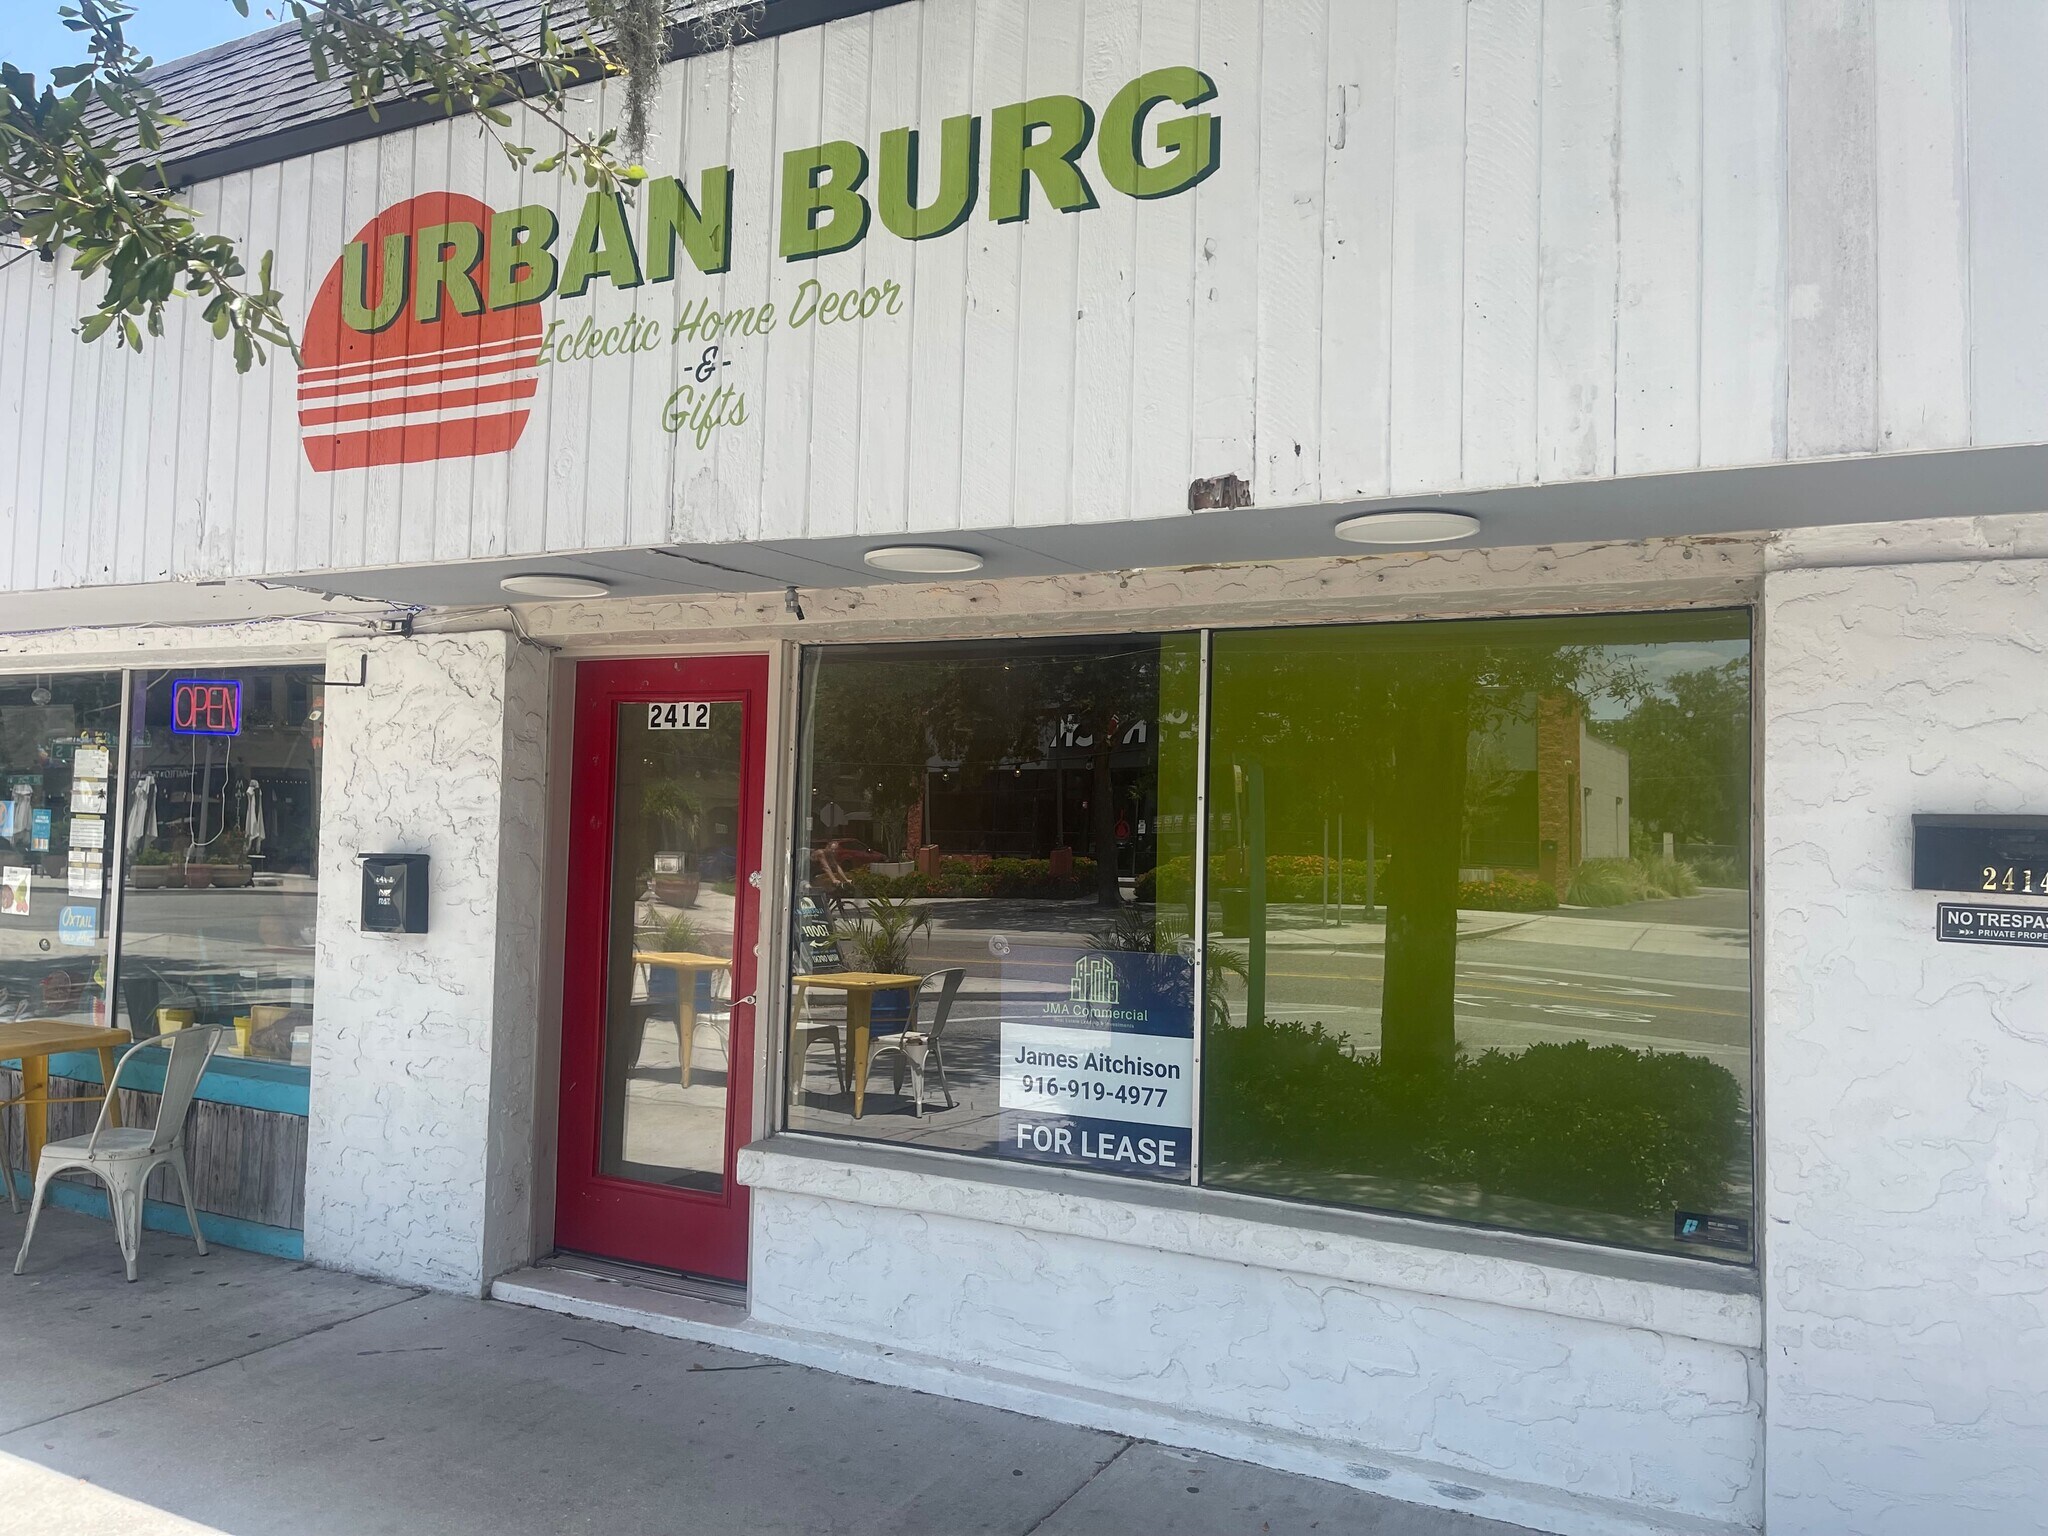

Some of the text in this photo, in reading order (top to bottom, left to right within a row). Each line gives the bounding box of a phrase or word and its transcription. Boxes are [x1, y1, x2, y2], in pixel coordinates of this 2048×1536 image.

[341, 66, 1221, 334] URBAN BURG
[536, 278, 903, 366] Eclectic Home Decor
[661, 383, 750, 451] Gifts
[175, 687, 237, 728] OPEN
[650, 704, 708, 728] 2412
[1982, 867, 2048, 894] 2414
[1948, 911, 1973, 925] NO
[1978, 929, 2015, 939] PRIVATE
[1043, 1003, 1149, 1021] JMA Commercial
[1014, 1046, 1180, 1080] James Aitchison
[1022, 1074, 1168, 1108] 916-919-4977
[1017, 1123, 1177, 1168] FOR LEASE
